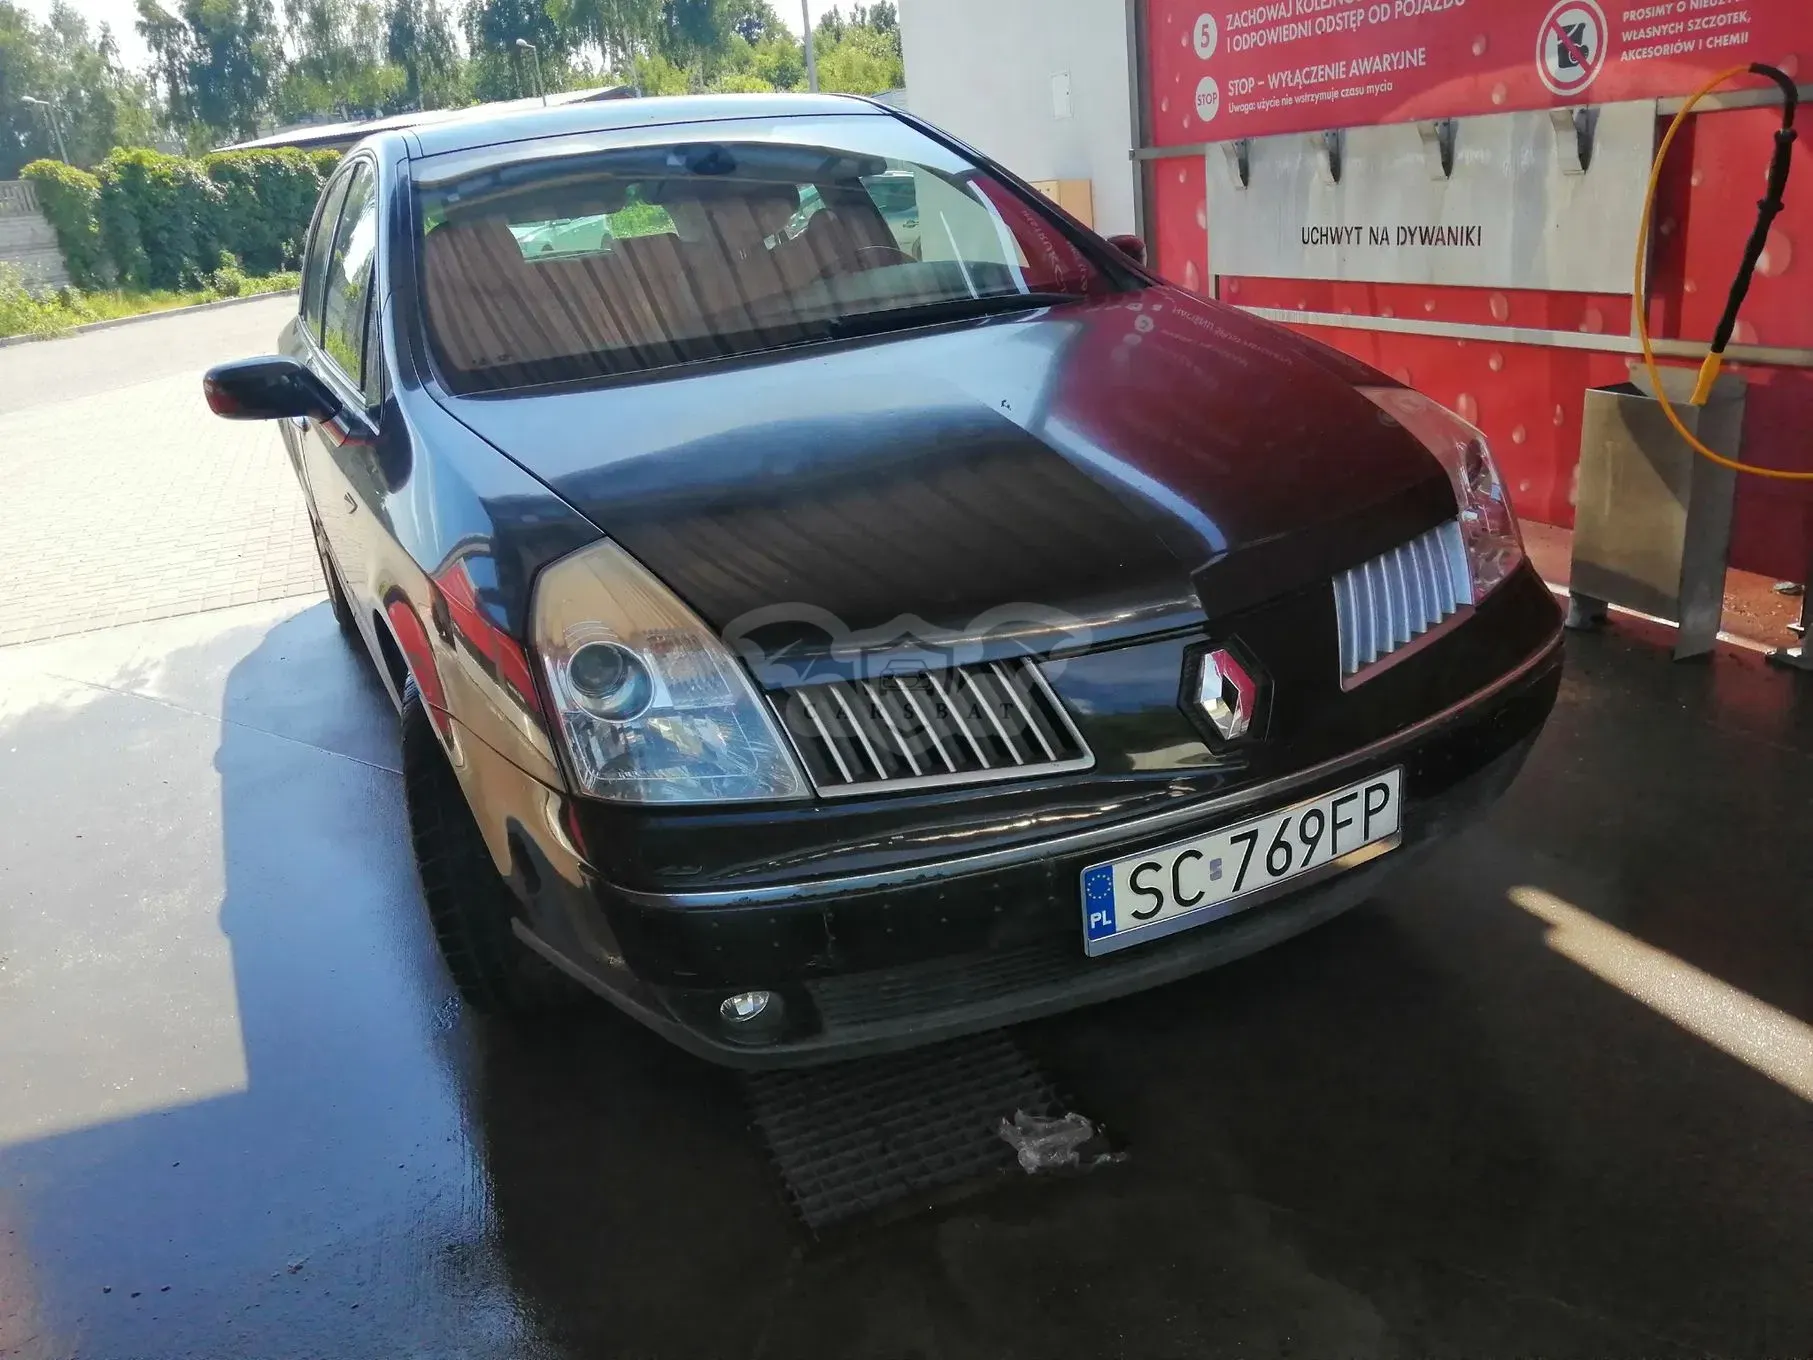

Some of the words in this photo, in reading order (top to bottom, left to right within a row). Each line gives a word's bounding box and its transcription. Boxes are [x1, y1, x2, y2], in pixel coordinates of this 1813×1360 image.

[1226, 0, 1292, 31] ZACHOWAJ
[1621, 22, 1684, 42] WŁASNYCH
[1687, 10, 1752, 31] SZCZOTEK,
[1622, 3, 1673, 22] PROSIMY
[1676, 1, 1686, 13] O
[1201, 23, 1211, 48] 5
[1227, 37, 1231, 52] I
[1233, 19, 1312, 51] ODPOWIEDNI
[1315, 8, 1365, 35] ODSTĘP
[1368, 3, 1391, 24] OD
[1620, 39, 1695, 62] AKCESORIÓW
[1706, 31, 1749, 48] CHEMII
[1228, 77, 1255, 96] STOP
[1267, 61, 1346, 89] WYŁĄCZENIE
[1349, 47, 1426, 78] AWARYJNE
[1197, 93, 1218, 106] STOP
[1228, 102, 1256, 114] Uwaga:
[1257, 96, 1279, 111] użycie
[1281, 93, 1293, 106] nie
[1294, 87, 1339, 104] wstrzymuje
[1340, 85, 1365, 98] czasu
[1366, 79, 1393, 96] mycia
[1301, 226, 1363, 245] UCHWYT
[1368, 226, 1390, 246] NA
[1396, 225, 1482, 247] DYWANIKI
[1128, 849, 1206, 921] SC
[1229, 781, 1390, 894] 769FP
[1090, 911, 1112, 930] PL
